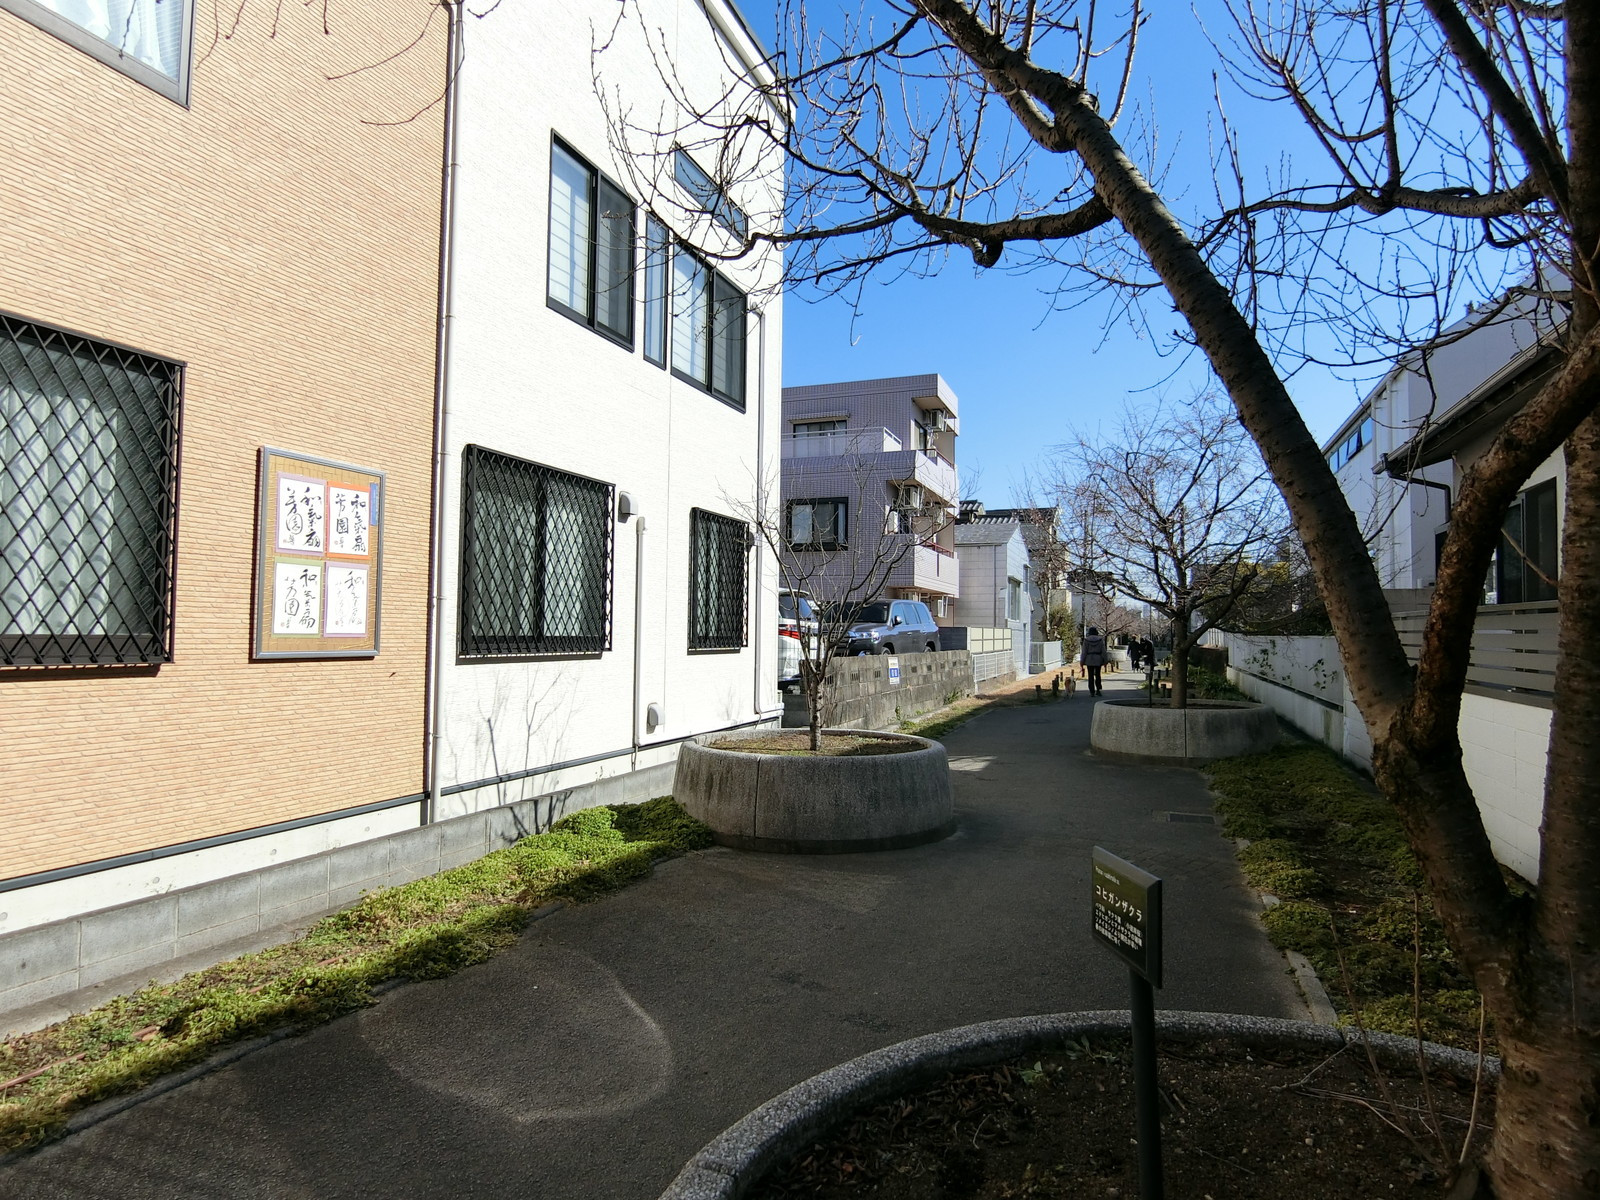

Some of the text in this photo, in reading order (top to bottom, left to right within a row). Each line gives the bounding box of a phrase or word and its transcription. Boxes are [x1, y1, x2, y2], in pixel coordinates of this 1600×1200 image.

[1096, 884, 1142, 922] コヒガンザクラ
